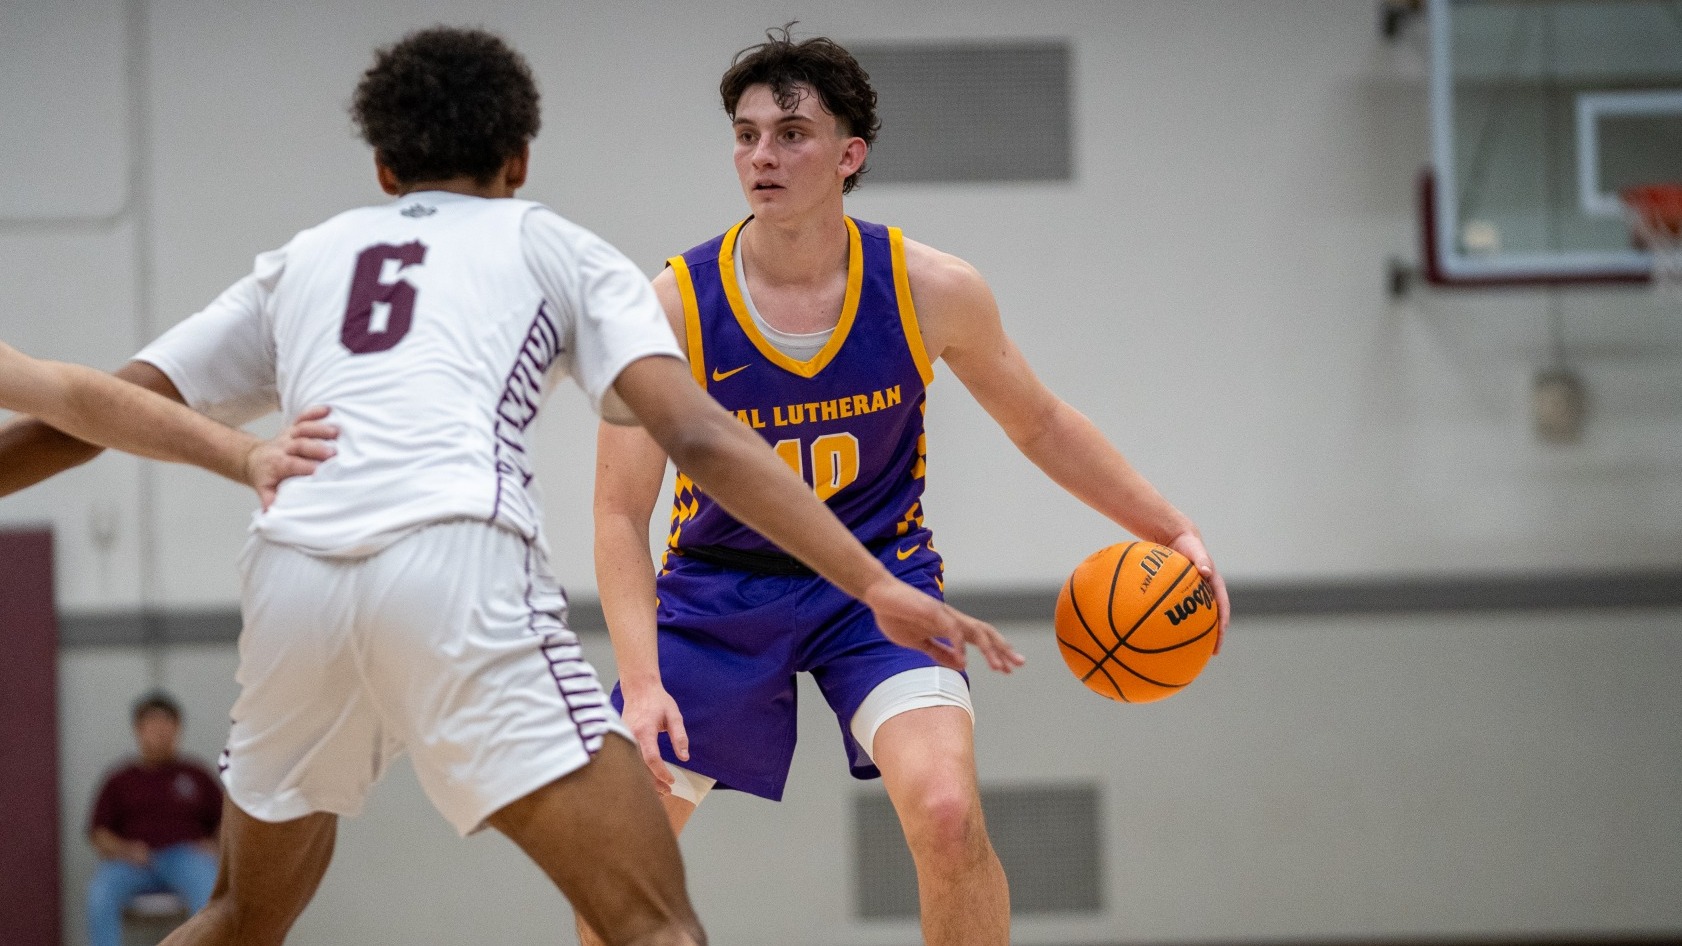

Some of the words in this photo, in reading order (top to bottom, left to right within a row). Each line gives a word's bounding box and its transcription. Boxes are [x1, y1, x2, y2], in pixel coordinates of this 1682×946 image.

[341, 239, 429, 354] 6
[732, 409, 766, 429] AL
[773, 385, 901, 427] LUTHERAN
[1164, 578, 1213, 626] ilson
